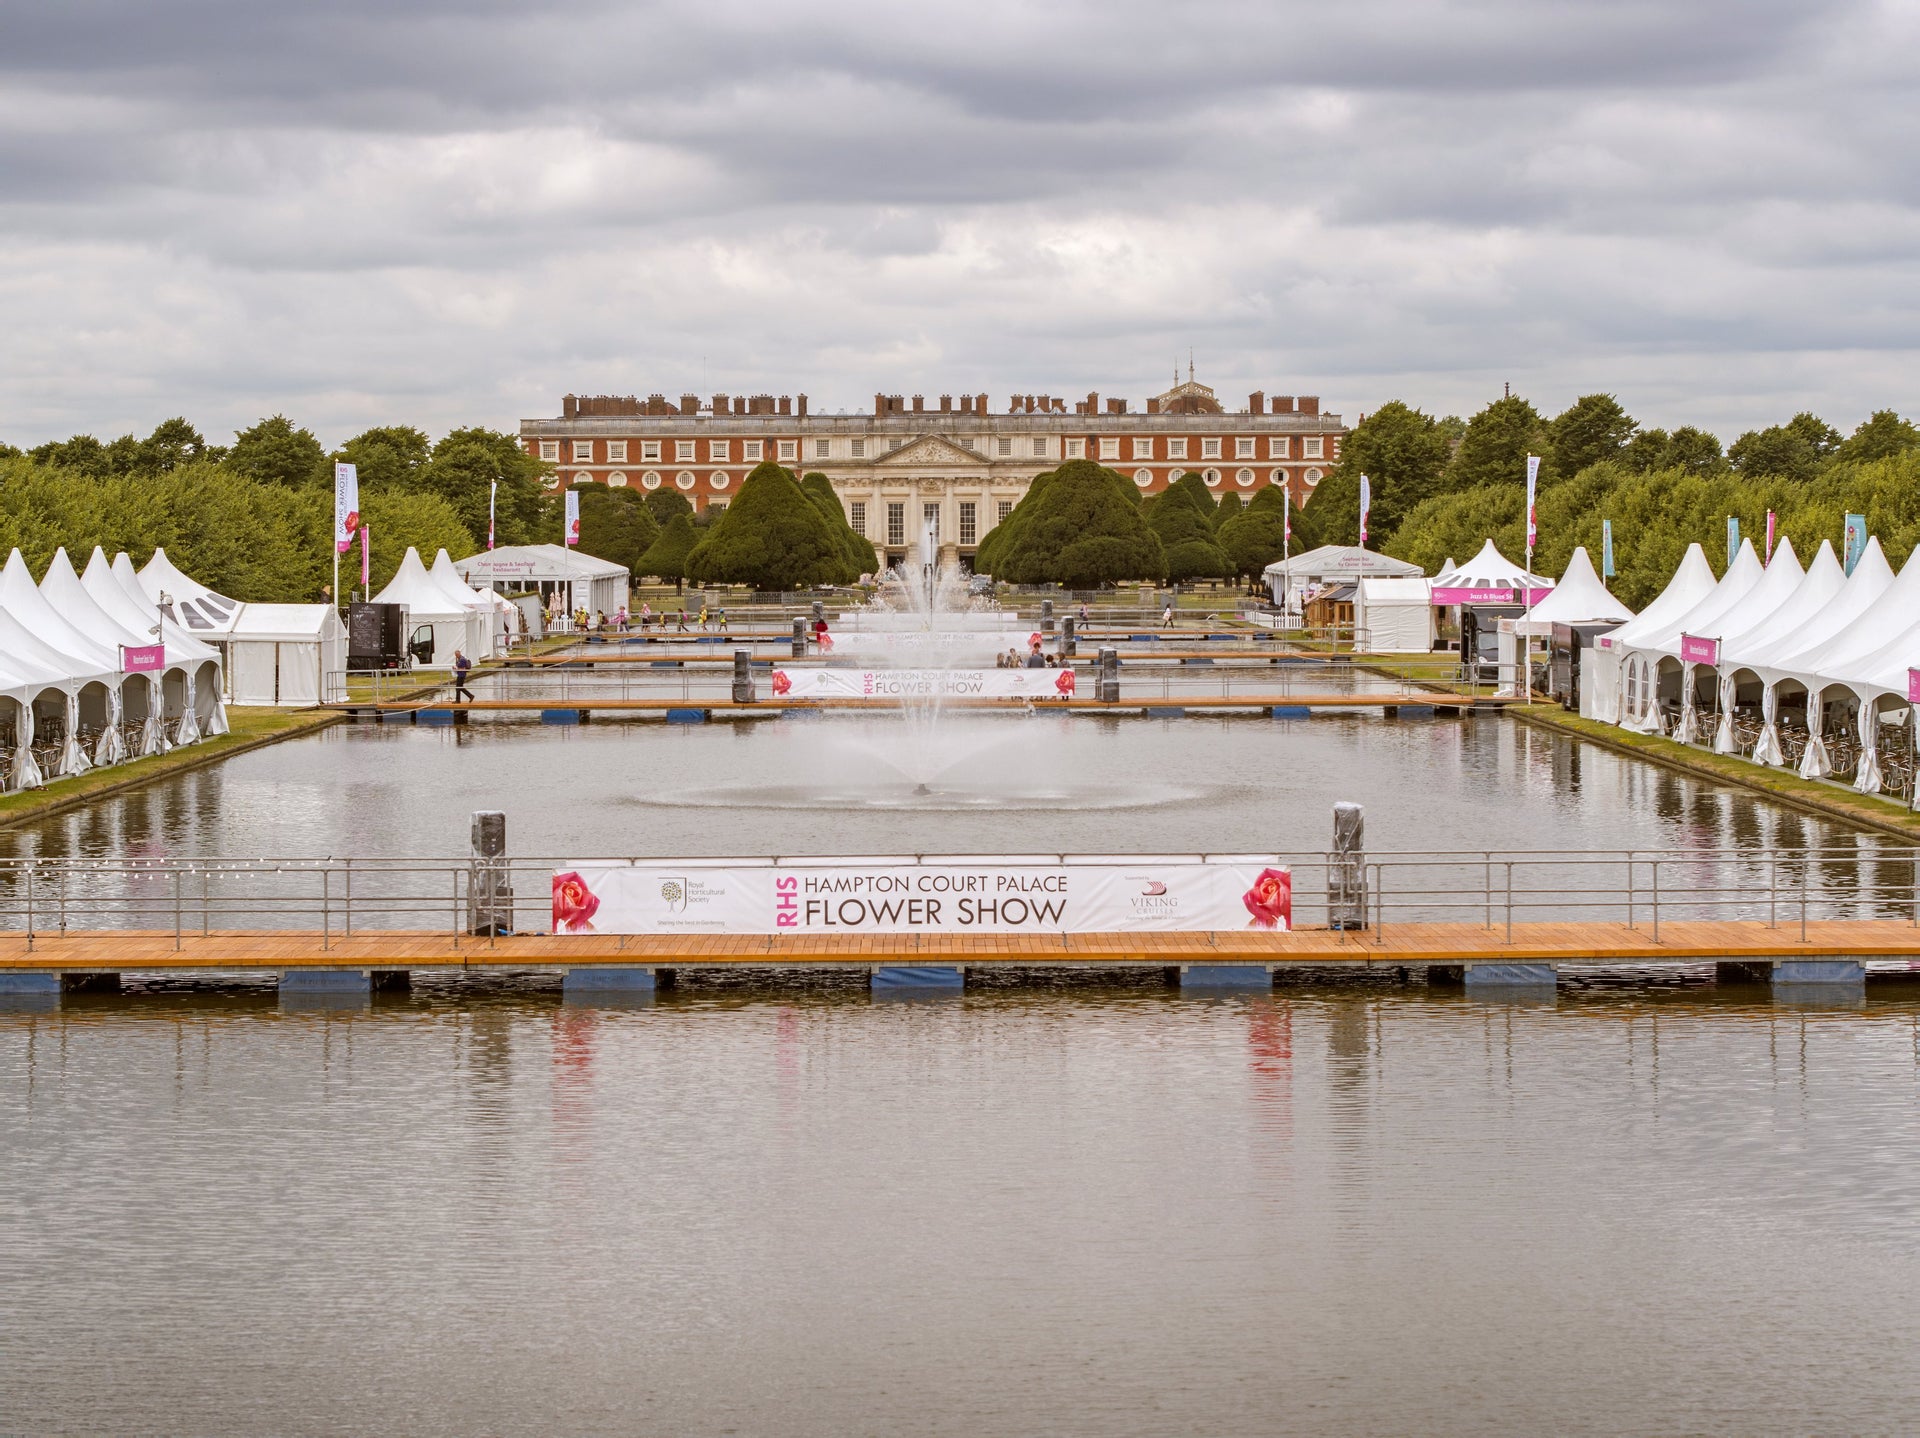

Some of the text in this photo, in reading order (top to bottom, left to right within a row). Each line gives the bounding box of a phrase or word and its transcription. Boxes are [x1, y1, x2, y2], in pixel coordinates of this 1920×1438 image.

[922, 672, 950, 680] COURT
[864, 673, 872, 694] RHS
[876, 682, 983, 694] FLOWER SHOW
[805, 876, 1068, 893] HAMPTON COURT PALACE
[688, 896, 710, 904] Society
[776, 876, 798, 927] RHS
[1131, 898, 1178, 907] VIKING
[806, 898, 1067, 926] FLOWER SHOW
